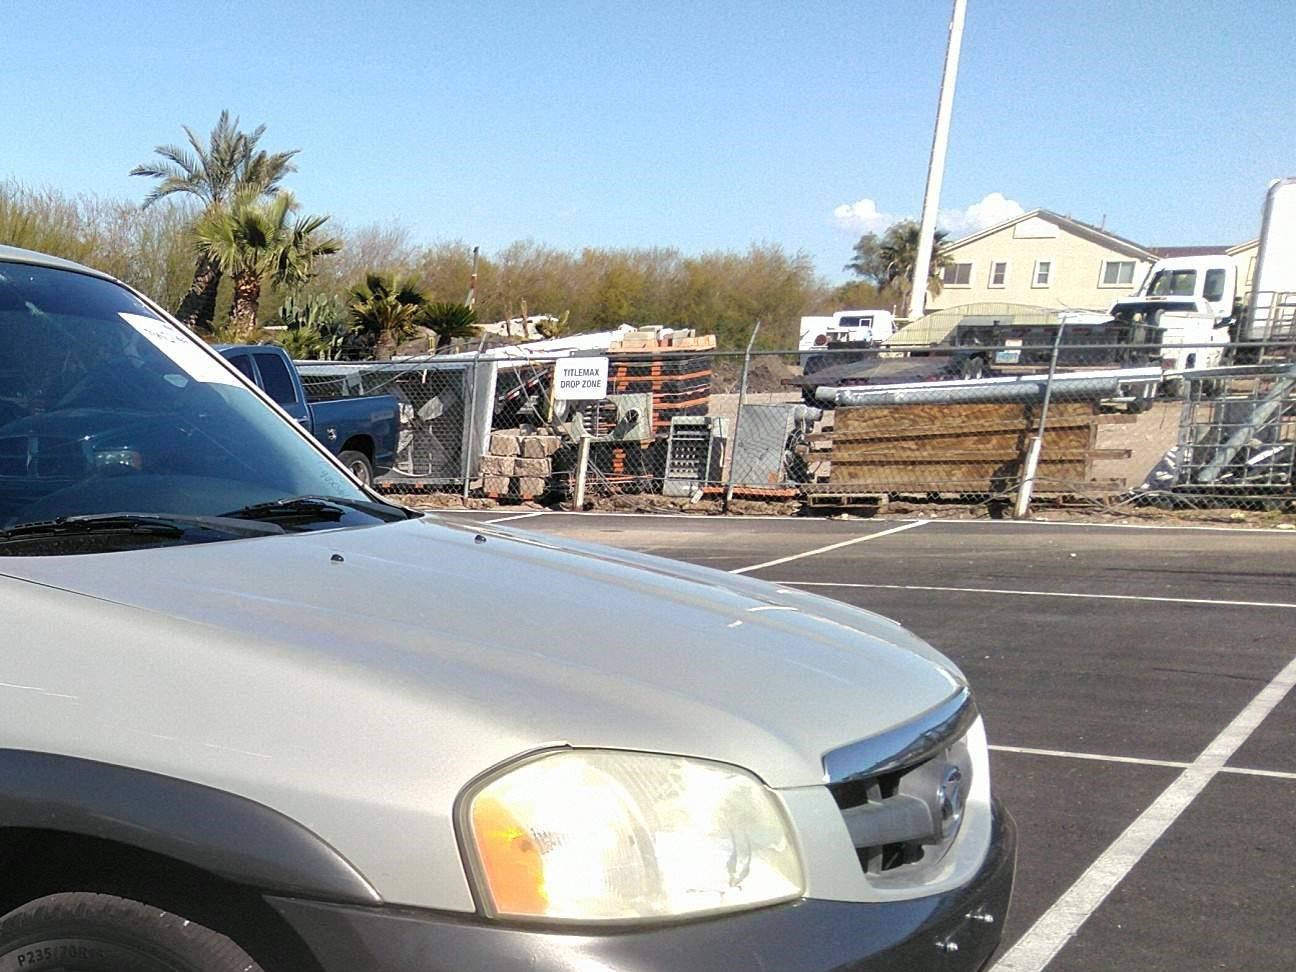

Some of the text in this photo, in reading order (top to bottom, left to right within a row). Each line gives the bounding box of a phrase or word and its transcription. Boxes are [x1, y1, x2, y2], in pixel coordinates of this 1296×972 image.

[563, 368, 600, 377] TITLEMAX
[560, 379, 602, 389] DROP ZONE
[17, 944, 106, 967] P235/70R
